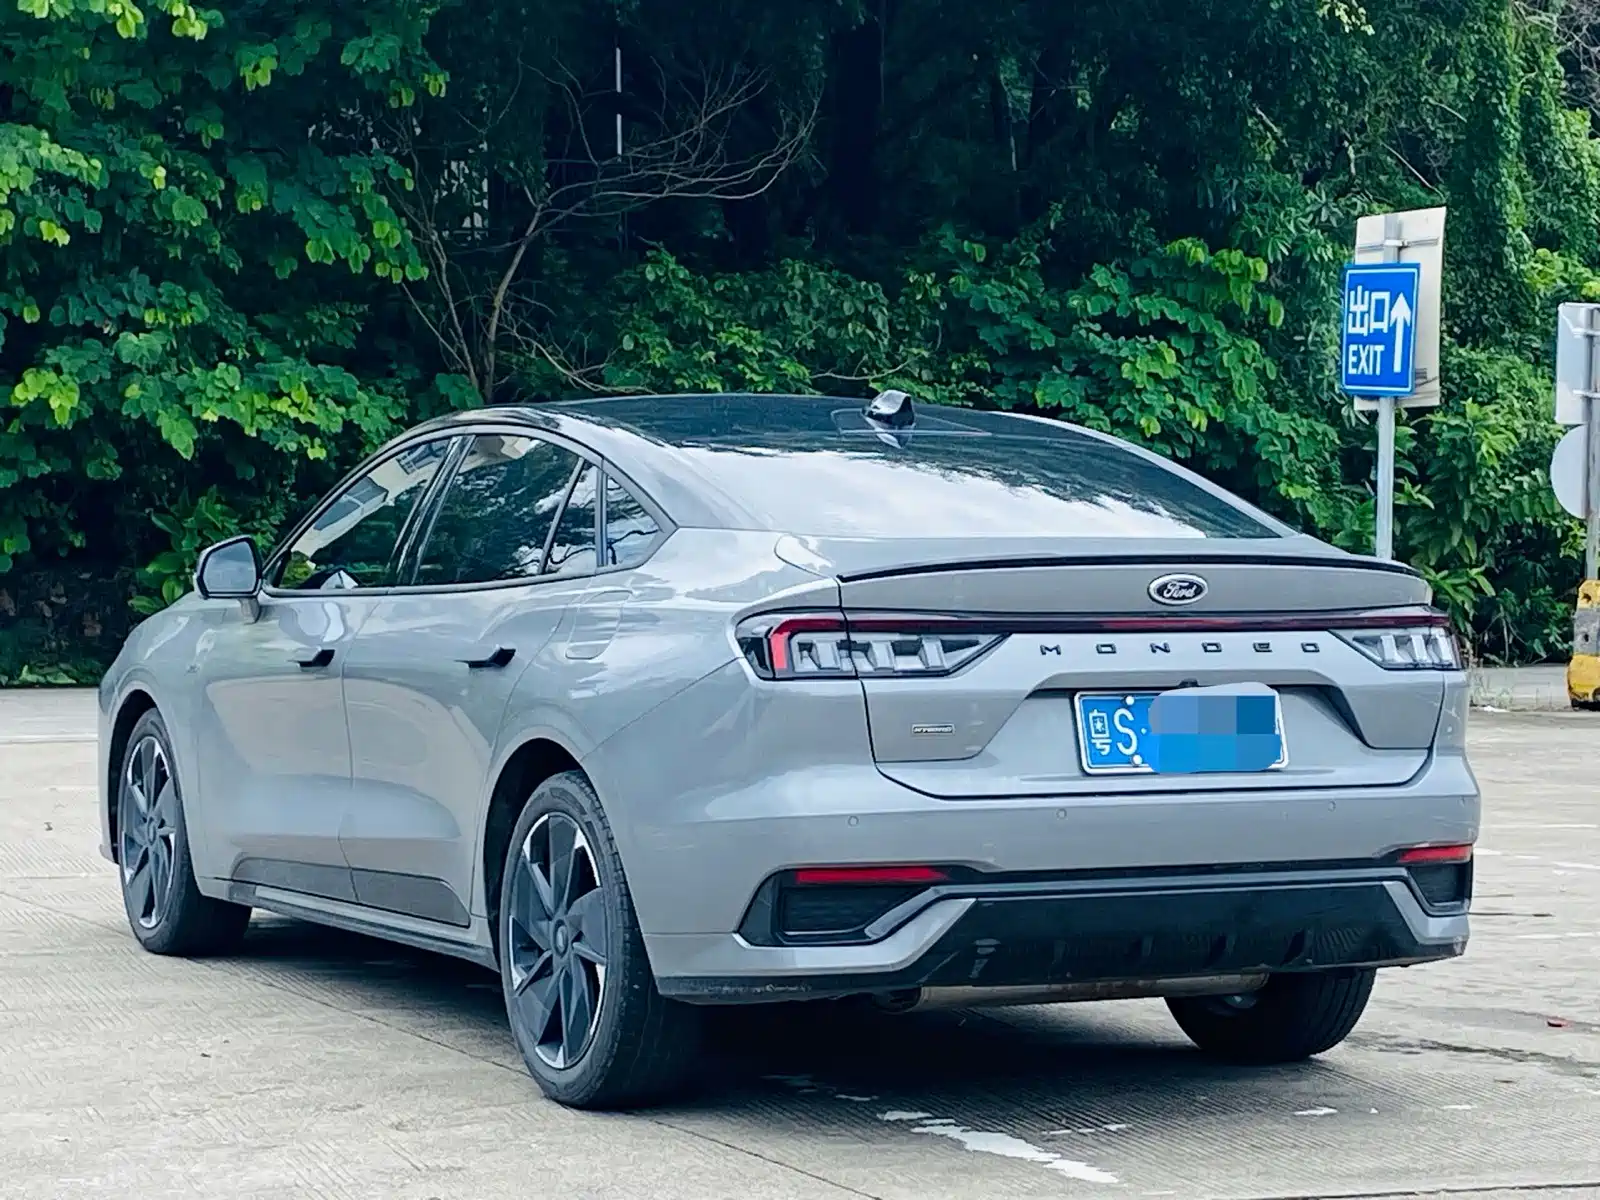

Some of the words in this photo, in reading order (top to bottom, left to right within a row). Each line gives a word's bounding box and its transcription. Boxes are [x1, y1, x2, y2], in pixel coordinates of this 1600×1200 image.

[1348, 285, 1390, 336] 出口
[1348, 344, 1385, 376] EXIT
[1163, 580, 1198, 599] Ford
[1039, 641, 1321, 656] MONDEO
